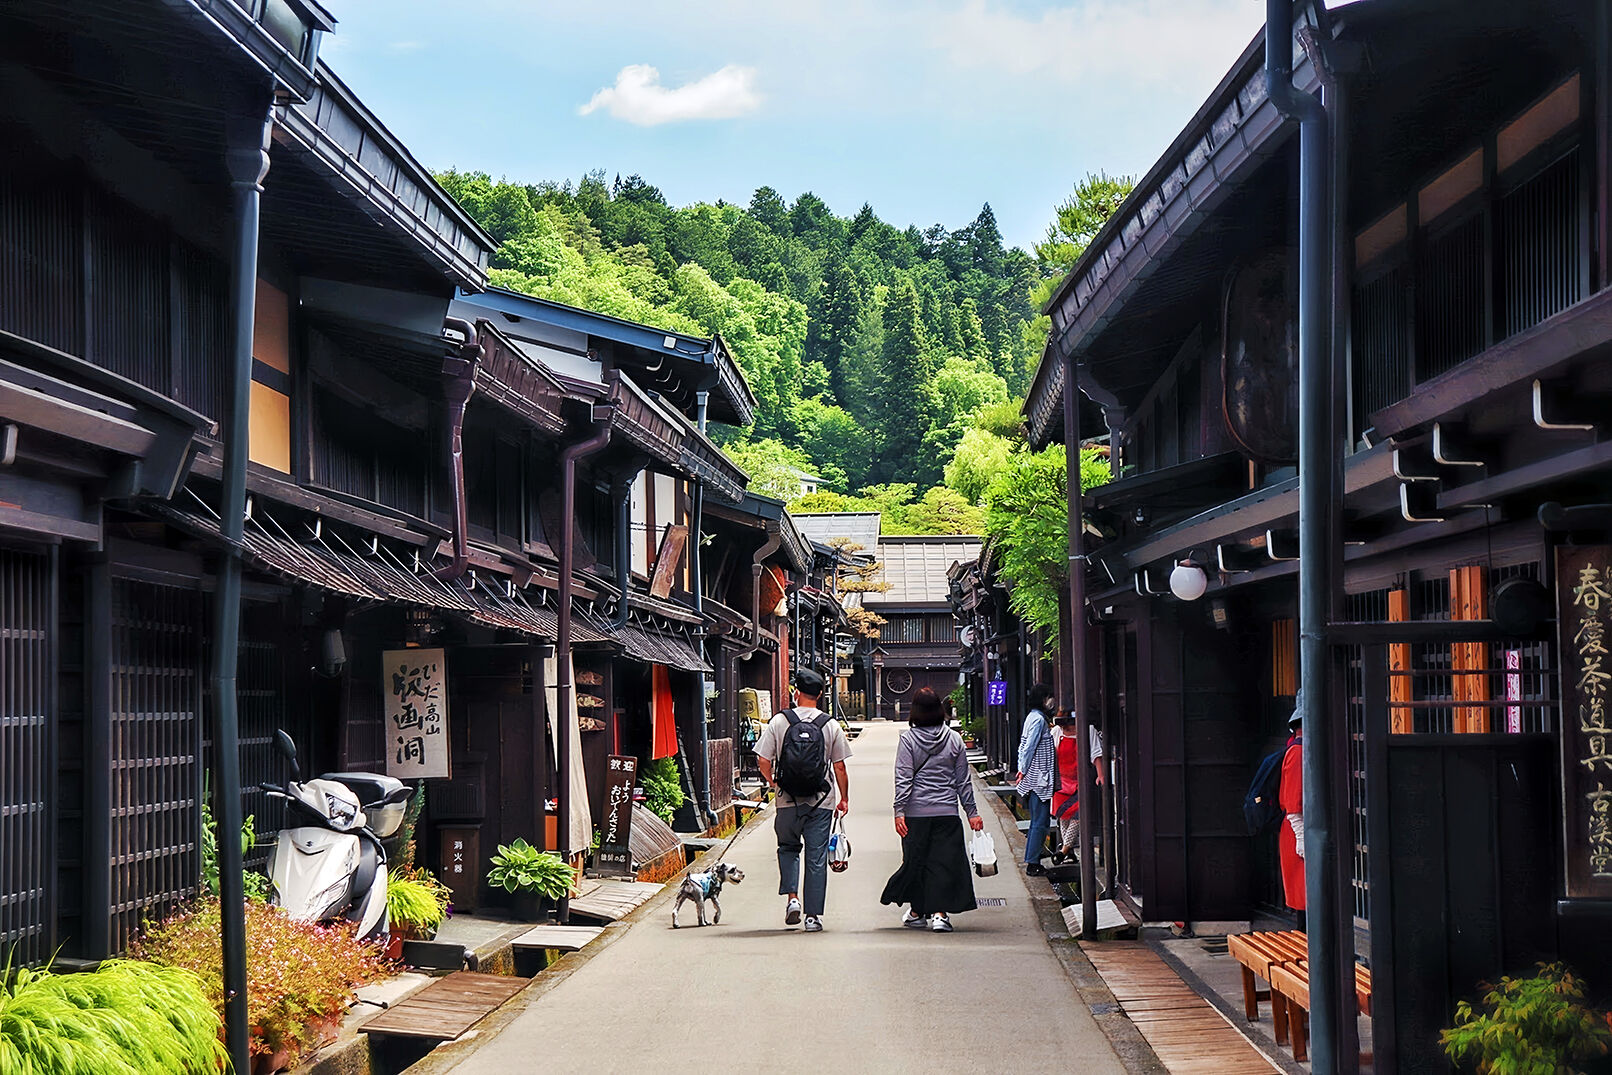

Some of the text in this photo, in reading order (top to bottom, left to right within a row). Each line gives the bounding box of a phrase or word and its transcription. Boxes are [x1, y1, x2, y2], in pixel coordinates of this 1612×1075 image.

[392, 664, 426, 765] 版画洞
[422, 663, 441, 735] ひだ高山
[453, 840, 463, 873] 消火器
